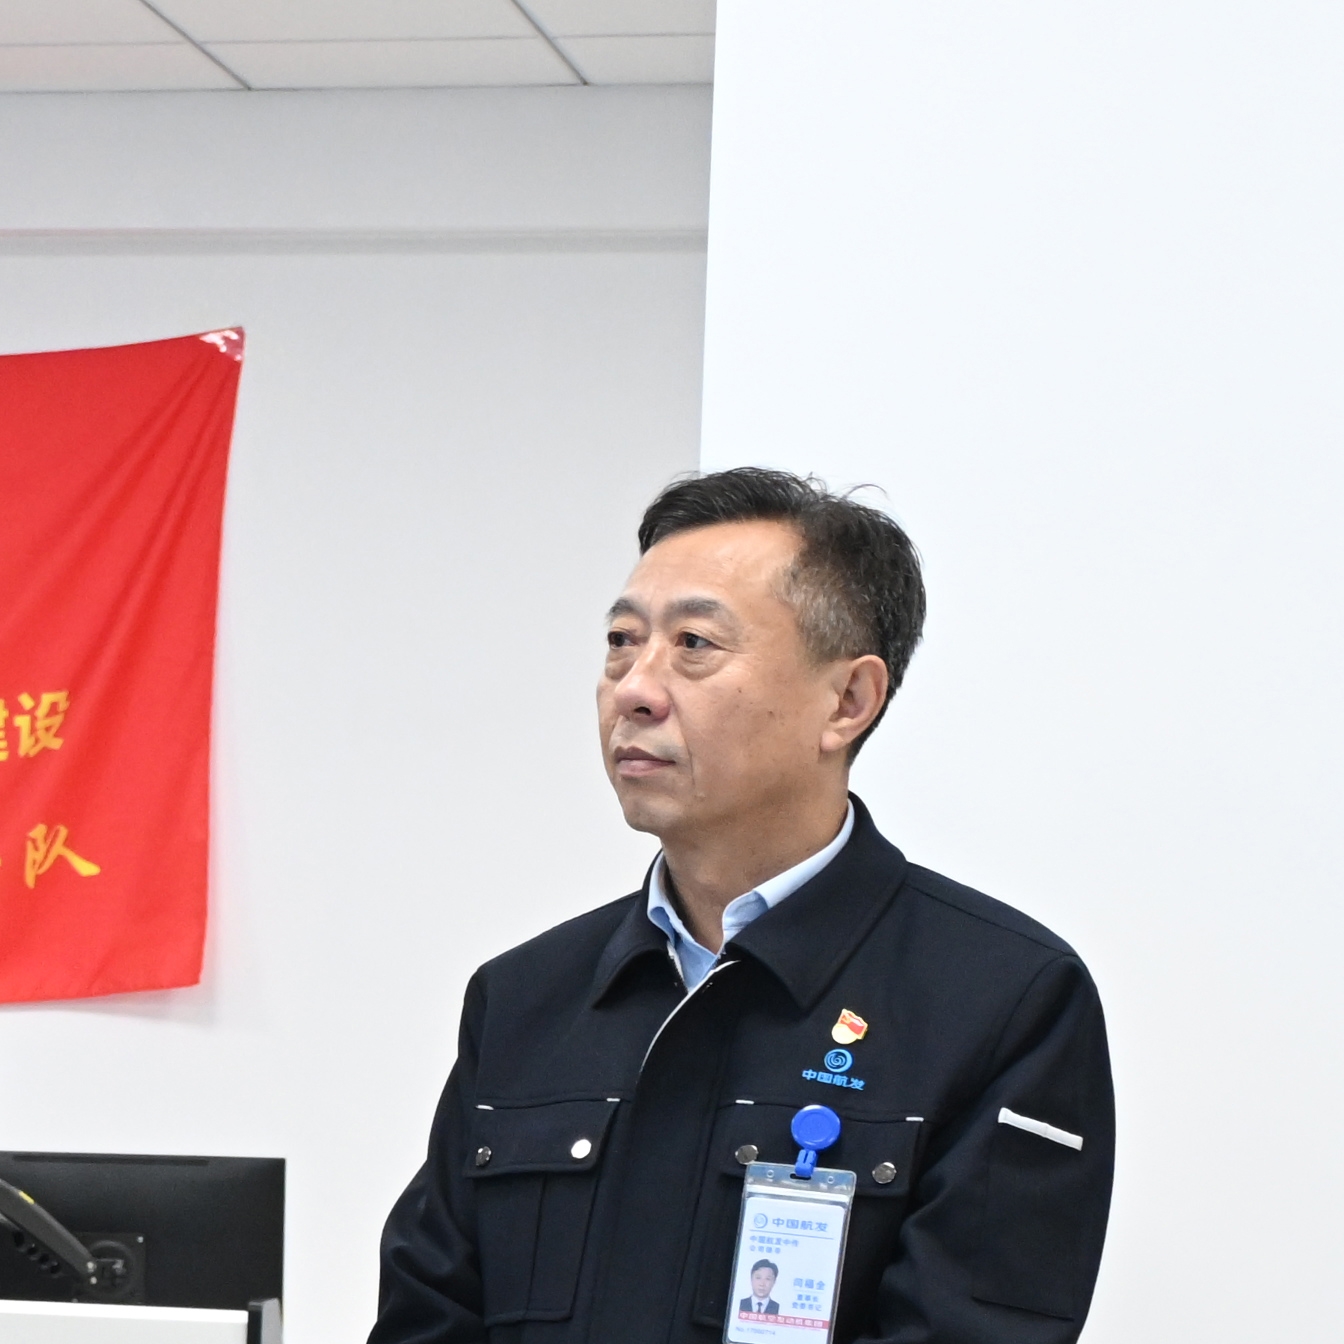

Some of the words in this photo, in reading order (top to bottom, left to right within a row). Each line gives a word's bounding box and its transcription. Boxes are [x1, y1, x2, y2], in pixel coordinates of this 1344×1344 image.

[801, 1069, 866, 1091] 中国航发
[772, 1217, 829, 1233] 中国航发
